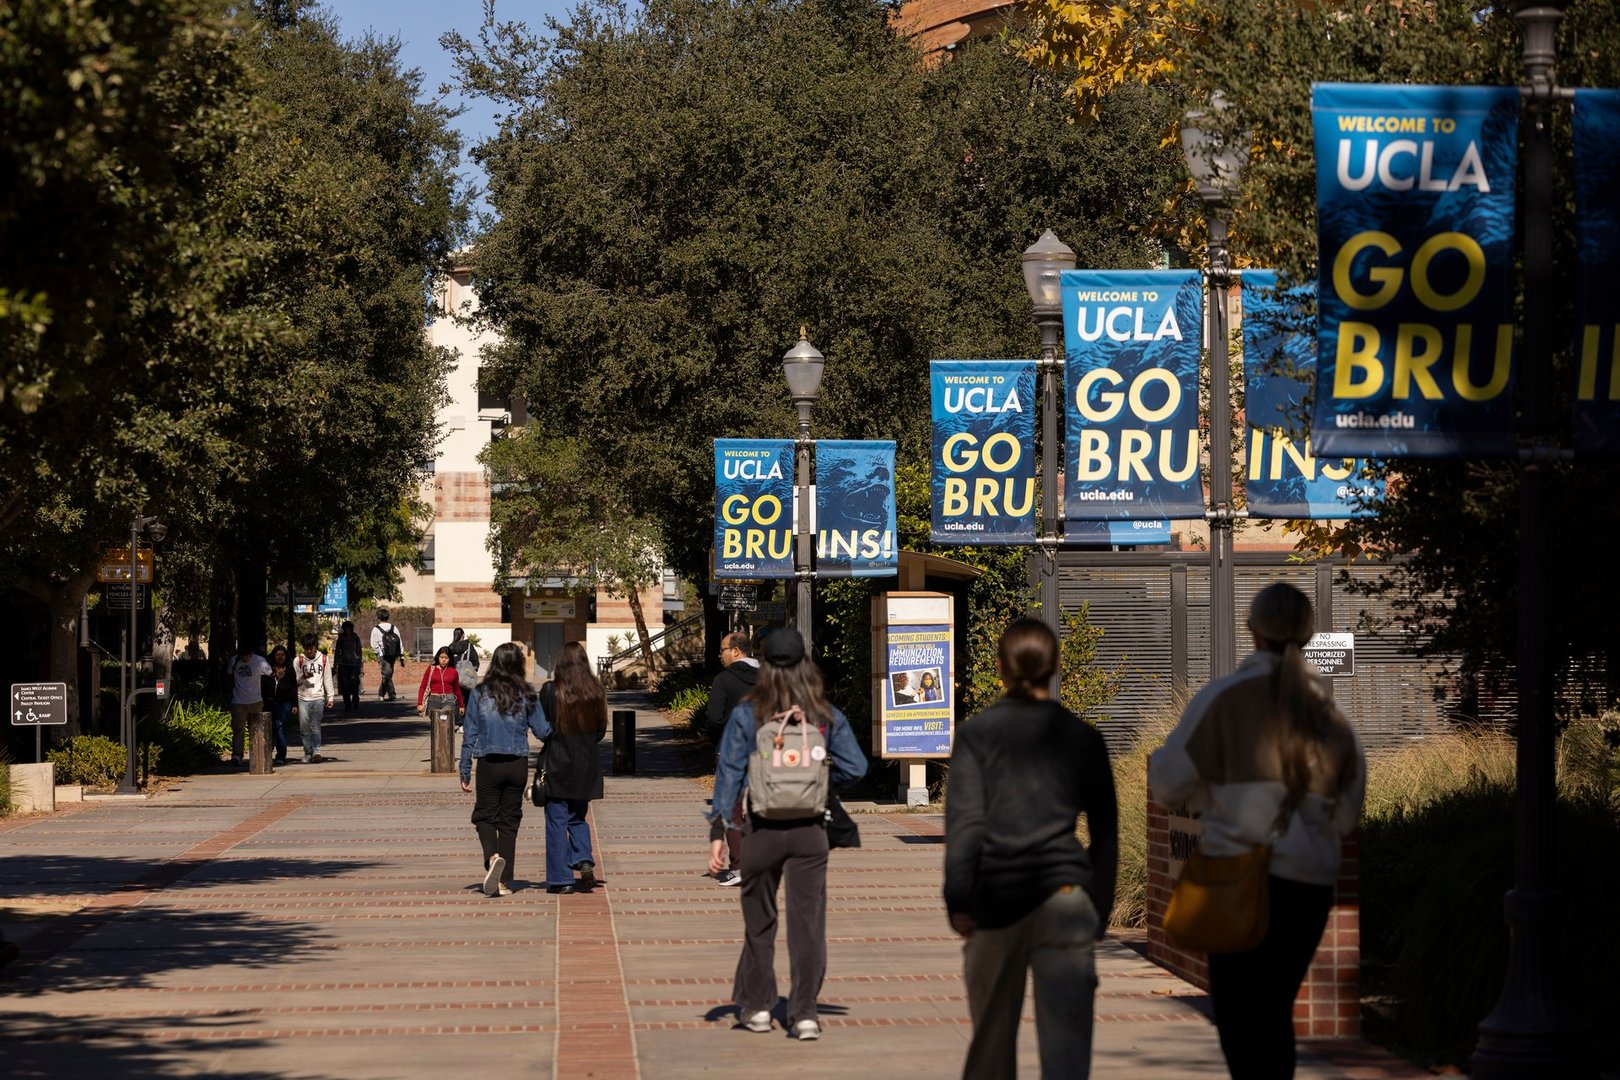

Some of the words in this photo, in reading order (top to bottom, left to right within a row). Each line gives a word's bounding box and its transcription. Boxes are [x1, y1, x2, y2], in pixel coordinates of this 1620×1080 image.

[1338, 116, 1426, 133] WELCOME
[1432, 117, 1456, 134] TO
[1336, 139, 1491, 193] UCLA
[1332, 230, 1487, 312] GO
[1078, 291, 1139, 302] WELCOME
[1143, 291, 1158, 302] TO
[1077, 305, 1183, 342] UCLA
[1332, 321, 1515, 401] BRU
[944, 375, 990, 384] WELCOME
[993, 375, 1005, 384] TO
[943, 387, 1023, 413] UCLA
[1075, 367, 1182, 423] GO
[1336, 411, 1416, 429] ucla.edu
[724, 450, 759, 458] WELCOME
[942, 432, 1021, 473] GO
[1076, 428, 1200, 483] BRU
[723, 459, 784, 480] UCLA
[942, 477, 1035, 517] BRU
[1080, 489, 1134, 501] ucla.edu
[722, 494, 782, 526] GO
[944, 523, 985, 531] ucla.edu
[1132, 519, 1163, 530] @ucla
[722, 528, 793, 560] BRU
[818, 528, 892, 560] INS!
[724, 562, 755, 570] ucla.edu
[888, 634, 915, 642] COMING
[889, 648, 943, 657] IMMUNIZATION
[889, 656, 945, 666] REQUIREMENTS
[302, 662, 323, 674] GAP
[1317, 665, 1335, 673] ONLY
[924, 721, 944, 731] VISIT:
